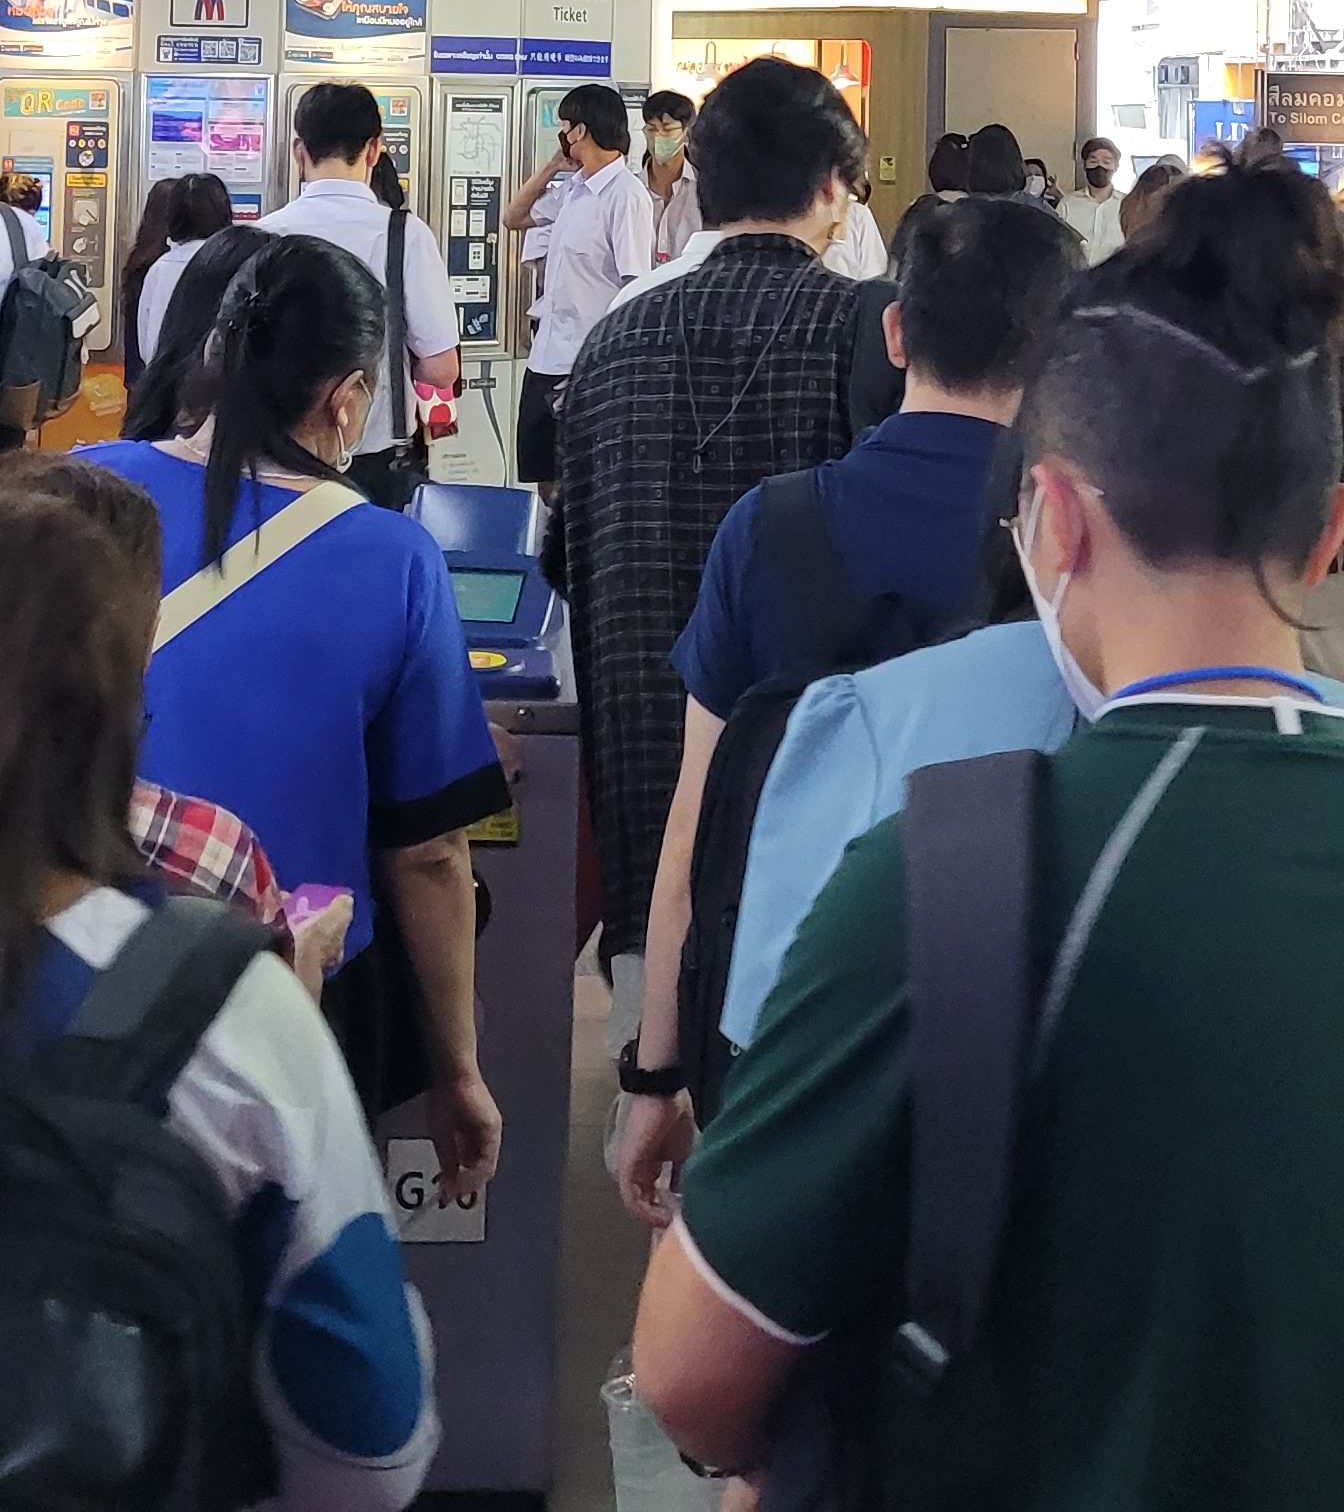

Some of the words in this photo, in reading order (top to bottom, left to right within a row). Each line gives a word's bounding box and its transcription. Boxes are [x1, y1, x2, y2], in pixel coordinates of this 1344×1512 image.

[553, 7, 588, 23] Ticket
[20, 89, 55, 115] QR
[1269, 111, 1287, 125] To
[1289, 111, 1328, 125] Silom
